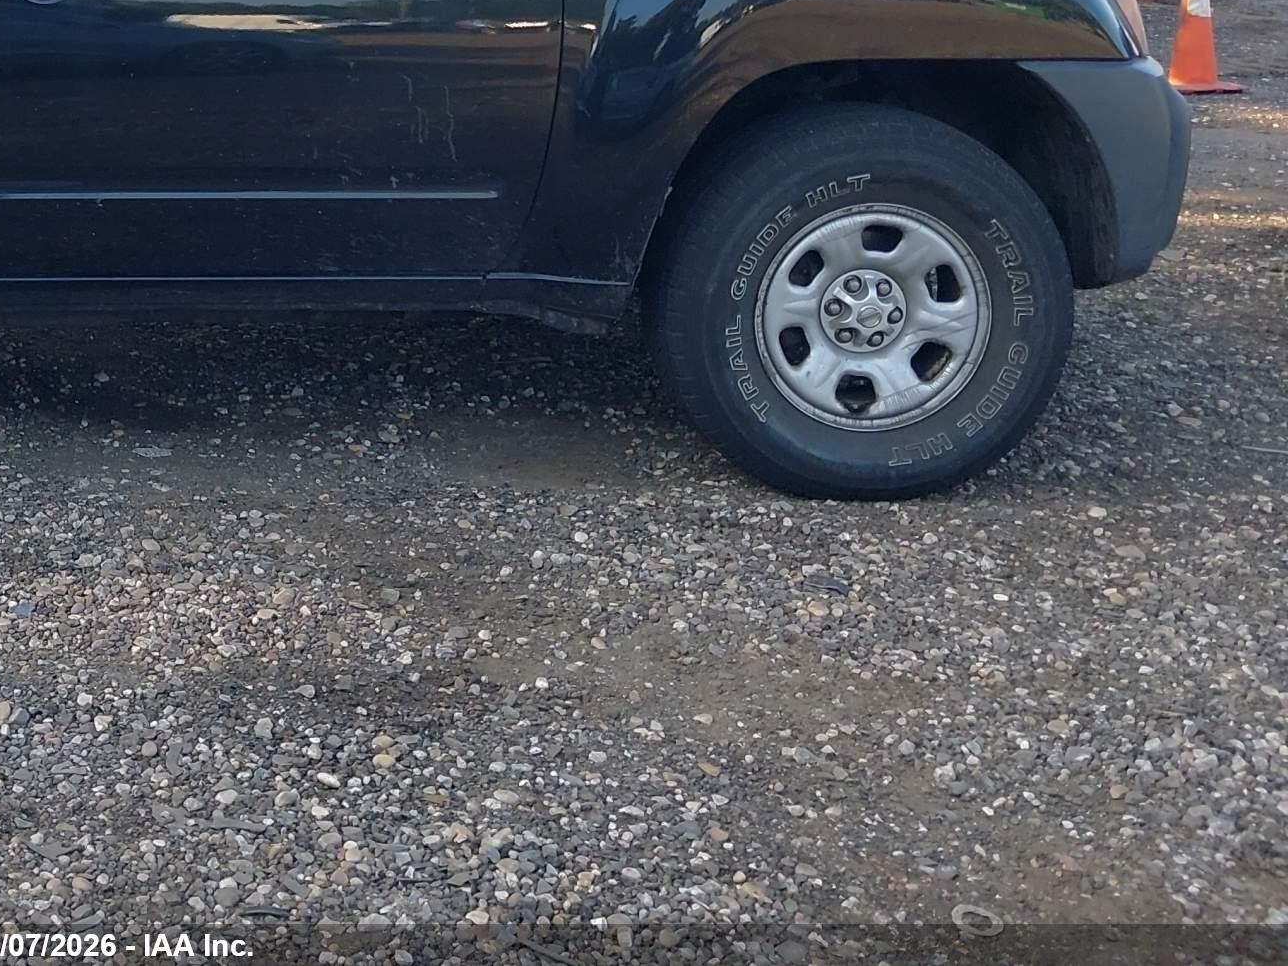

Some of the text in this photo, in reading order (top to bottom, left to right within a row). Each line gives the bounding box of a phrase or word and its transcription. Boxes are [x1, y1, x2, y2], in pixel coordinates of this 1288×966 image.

[724, 173, 871, 424] TRAIL GUIDE HLT
[888, 219, 1035, 468] TRAIL GUIDE HLT
